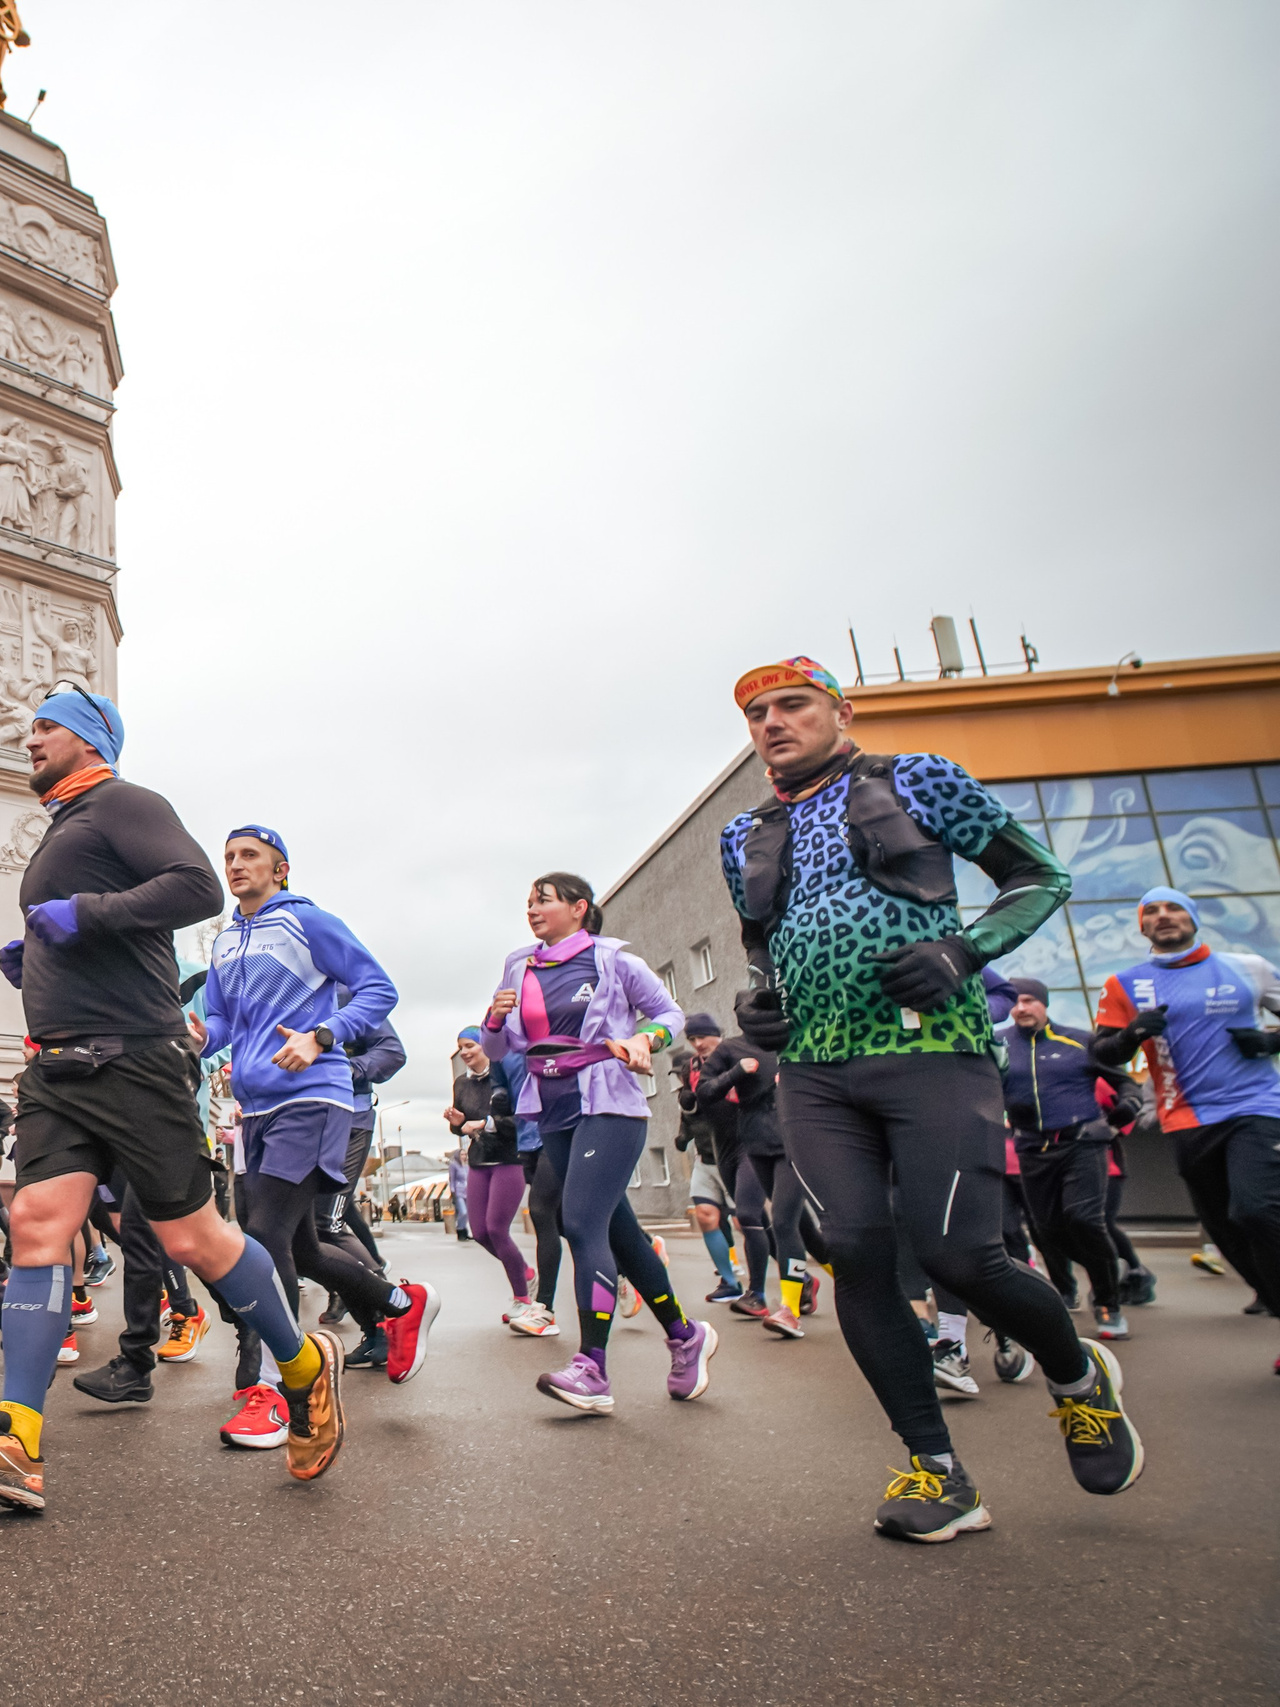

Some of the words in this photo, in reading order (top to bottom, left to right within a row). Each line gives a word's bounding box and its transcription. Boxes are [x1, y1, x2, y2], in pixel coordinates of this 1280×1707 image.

[737, 679, 760, 698] NEVER
[761, 672, 781, 687] GIVE
[784, 669, 799, 681] UP
